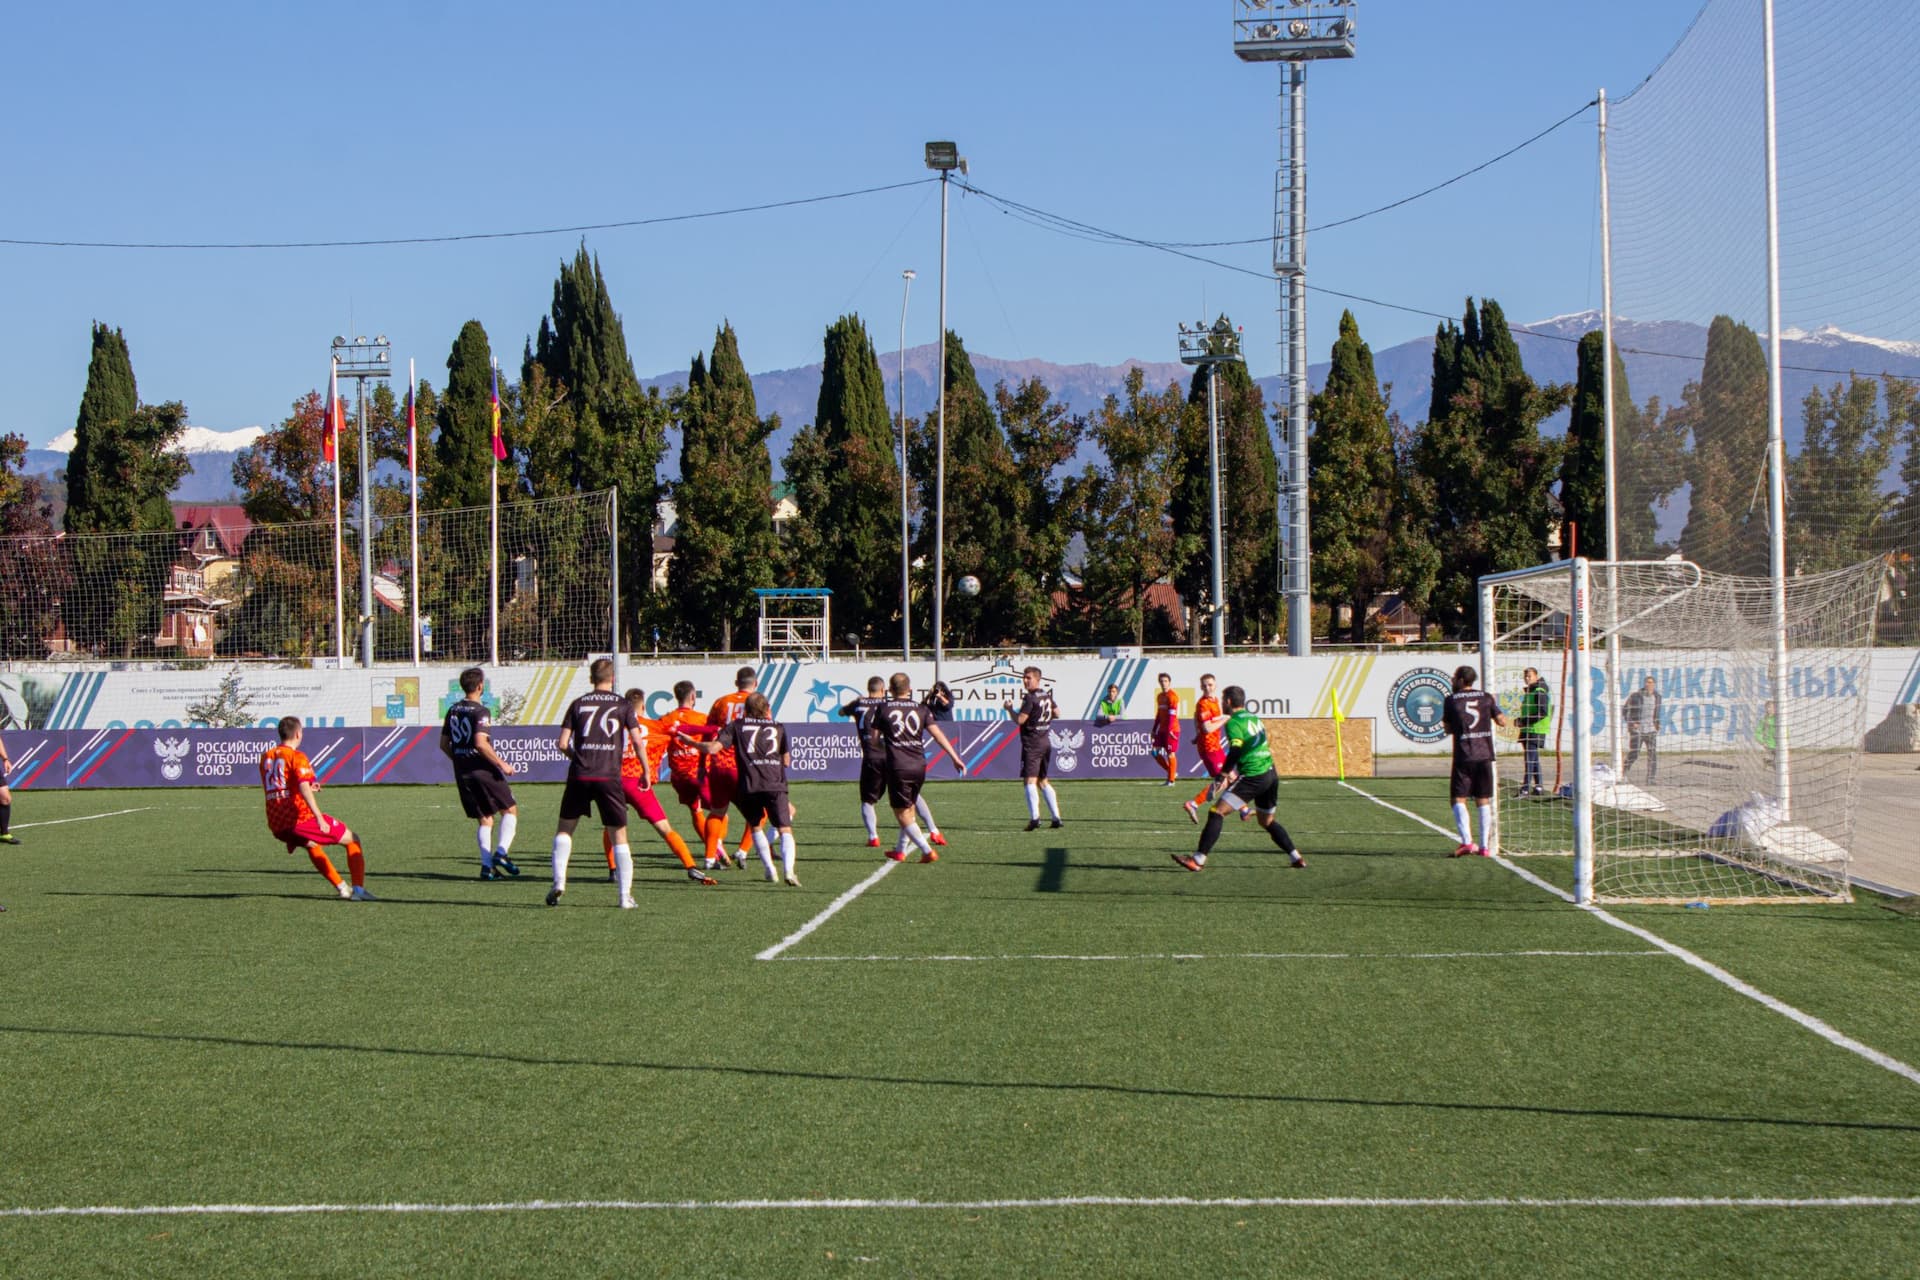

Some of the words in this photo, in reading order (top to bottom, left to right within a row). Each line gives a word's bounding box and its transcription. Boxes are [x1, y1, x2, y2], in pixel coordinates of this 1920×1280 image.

[578, 705, 620, 738] 76
[888, 709, 920, 738] 30
[1465, 699, 1480, 729] 5
[449, 714, 472, 744] 89
[742, 725, 778, 756] 73
[196, 752, 262, 764] ФУТБОЛЬН
[791, 747, 864, 759] ФУТБОЛЬНЫ
[1091, 756, 1128, 768] СОЮЗ
[196, 764, 232, 776] СОЮЗ
[791, 759, 827, 770] СОЮЗ
